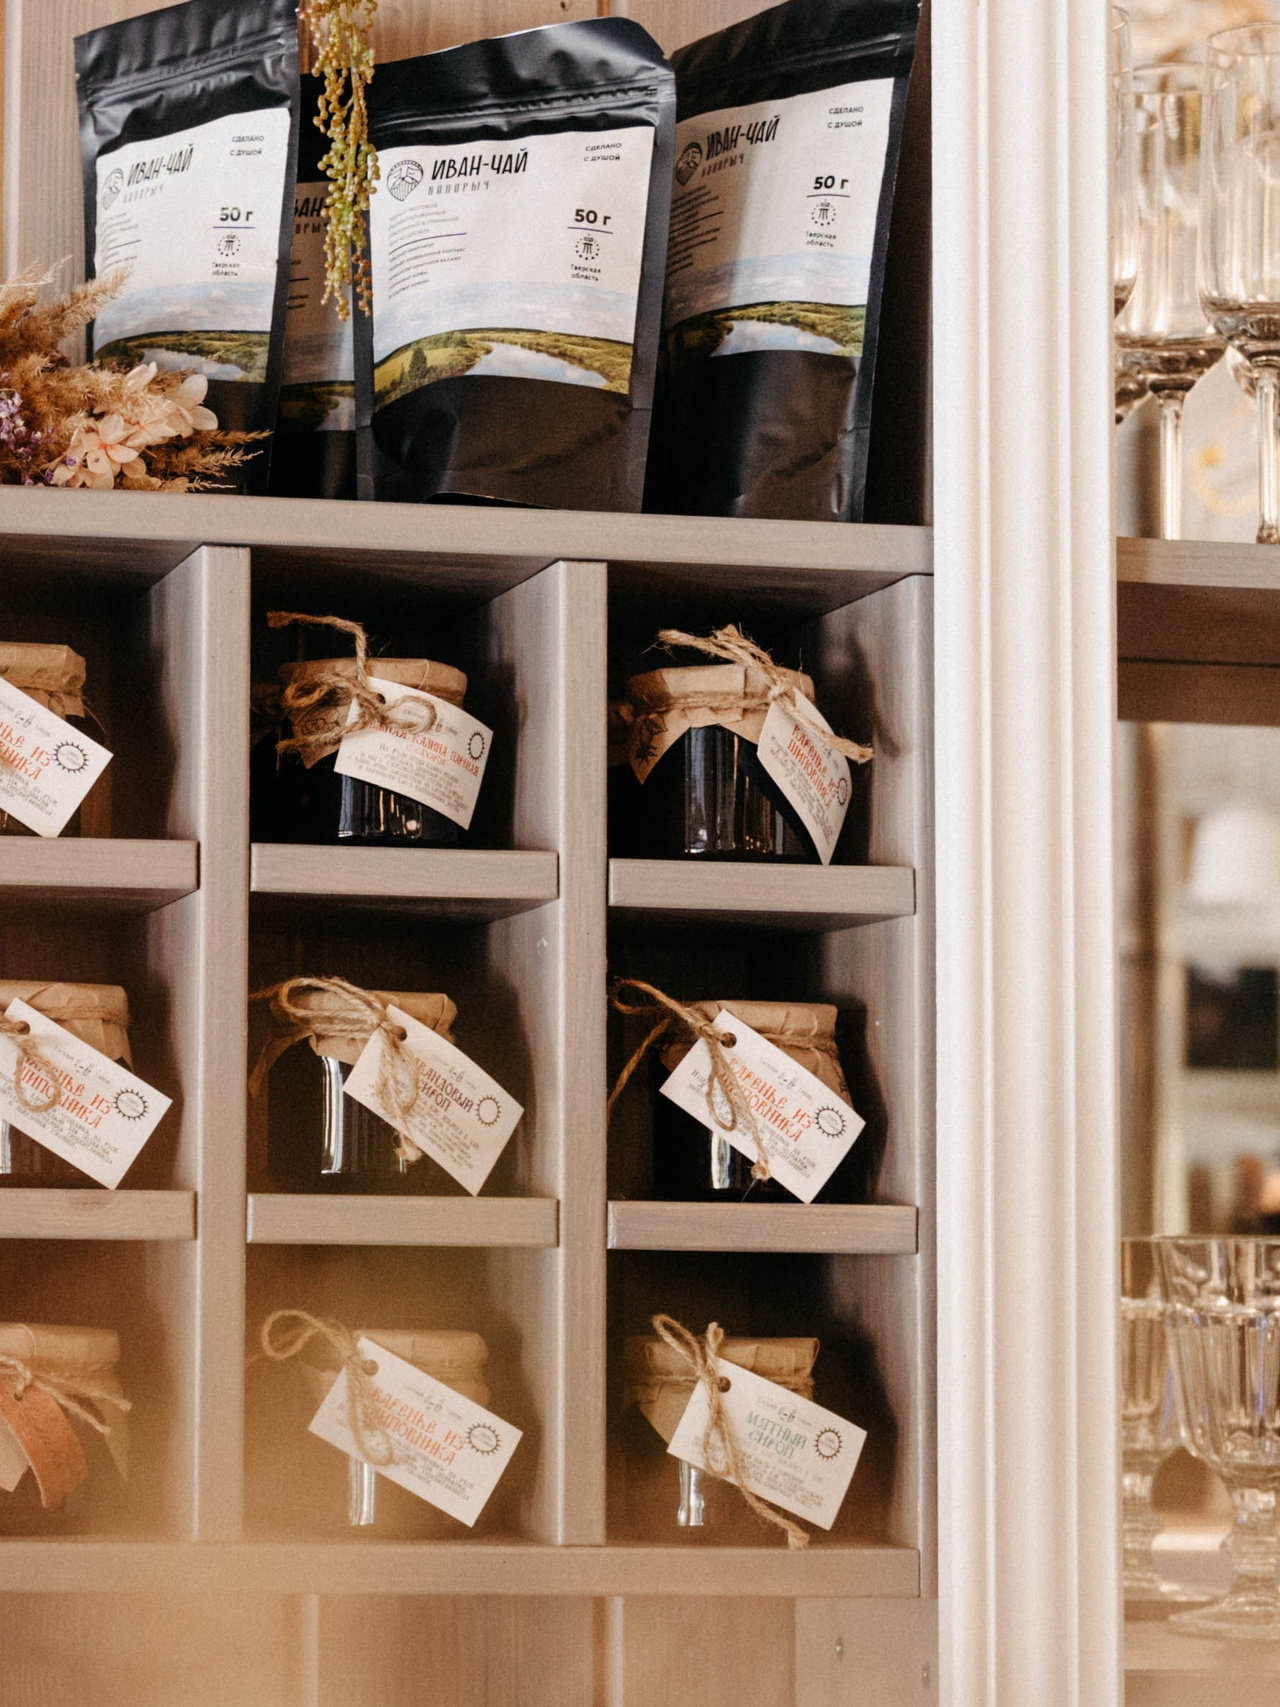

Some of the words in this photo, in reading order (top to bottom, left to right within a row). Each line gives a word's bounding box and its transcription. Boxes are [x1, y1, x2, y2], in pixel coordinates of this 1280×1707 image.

[828, 105, 864, 115] СДЕЛАНО
[835, 119, 862, 129] ДУШОЙ
[706, 115, 781, 161] ИВАН-ЧАЙ
[585, 143, 622, 151] СДЕЛАНО
[127, 144, 194, 187] ИВАН-ЧАЙ
[431, 147, 529, 180] ИВАН-ЧАЙ
[813, 175, 835, 190] 50
[840, 178, 849, 190] г
[220, 207, 241, 222] 50
[246, 210, 254, 222] г
[574, 208, 597, 224] 50
[603, 214, 611, 226] г
[806, 231, 837, 240] Тверская
[806, 239, 834, 248] область
[570, 263, 601, 274] Тверская
[571, 272, 599, 282] область
[30, 746, 52, 767] ИЗ
[90, 1093, 113, 1115] ИЗ
[791, 1106, 814, 1130] ИЗ
[443, 1429, 466, 1451] ИЗ
